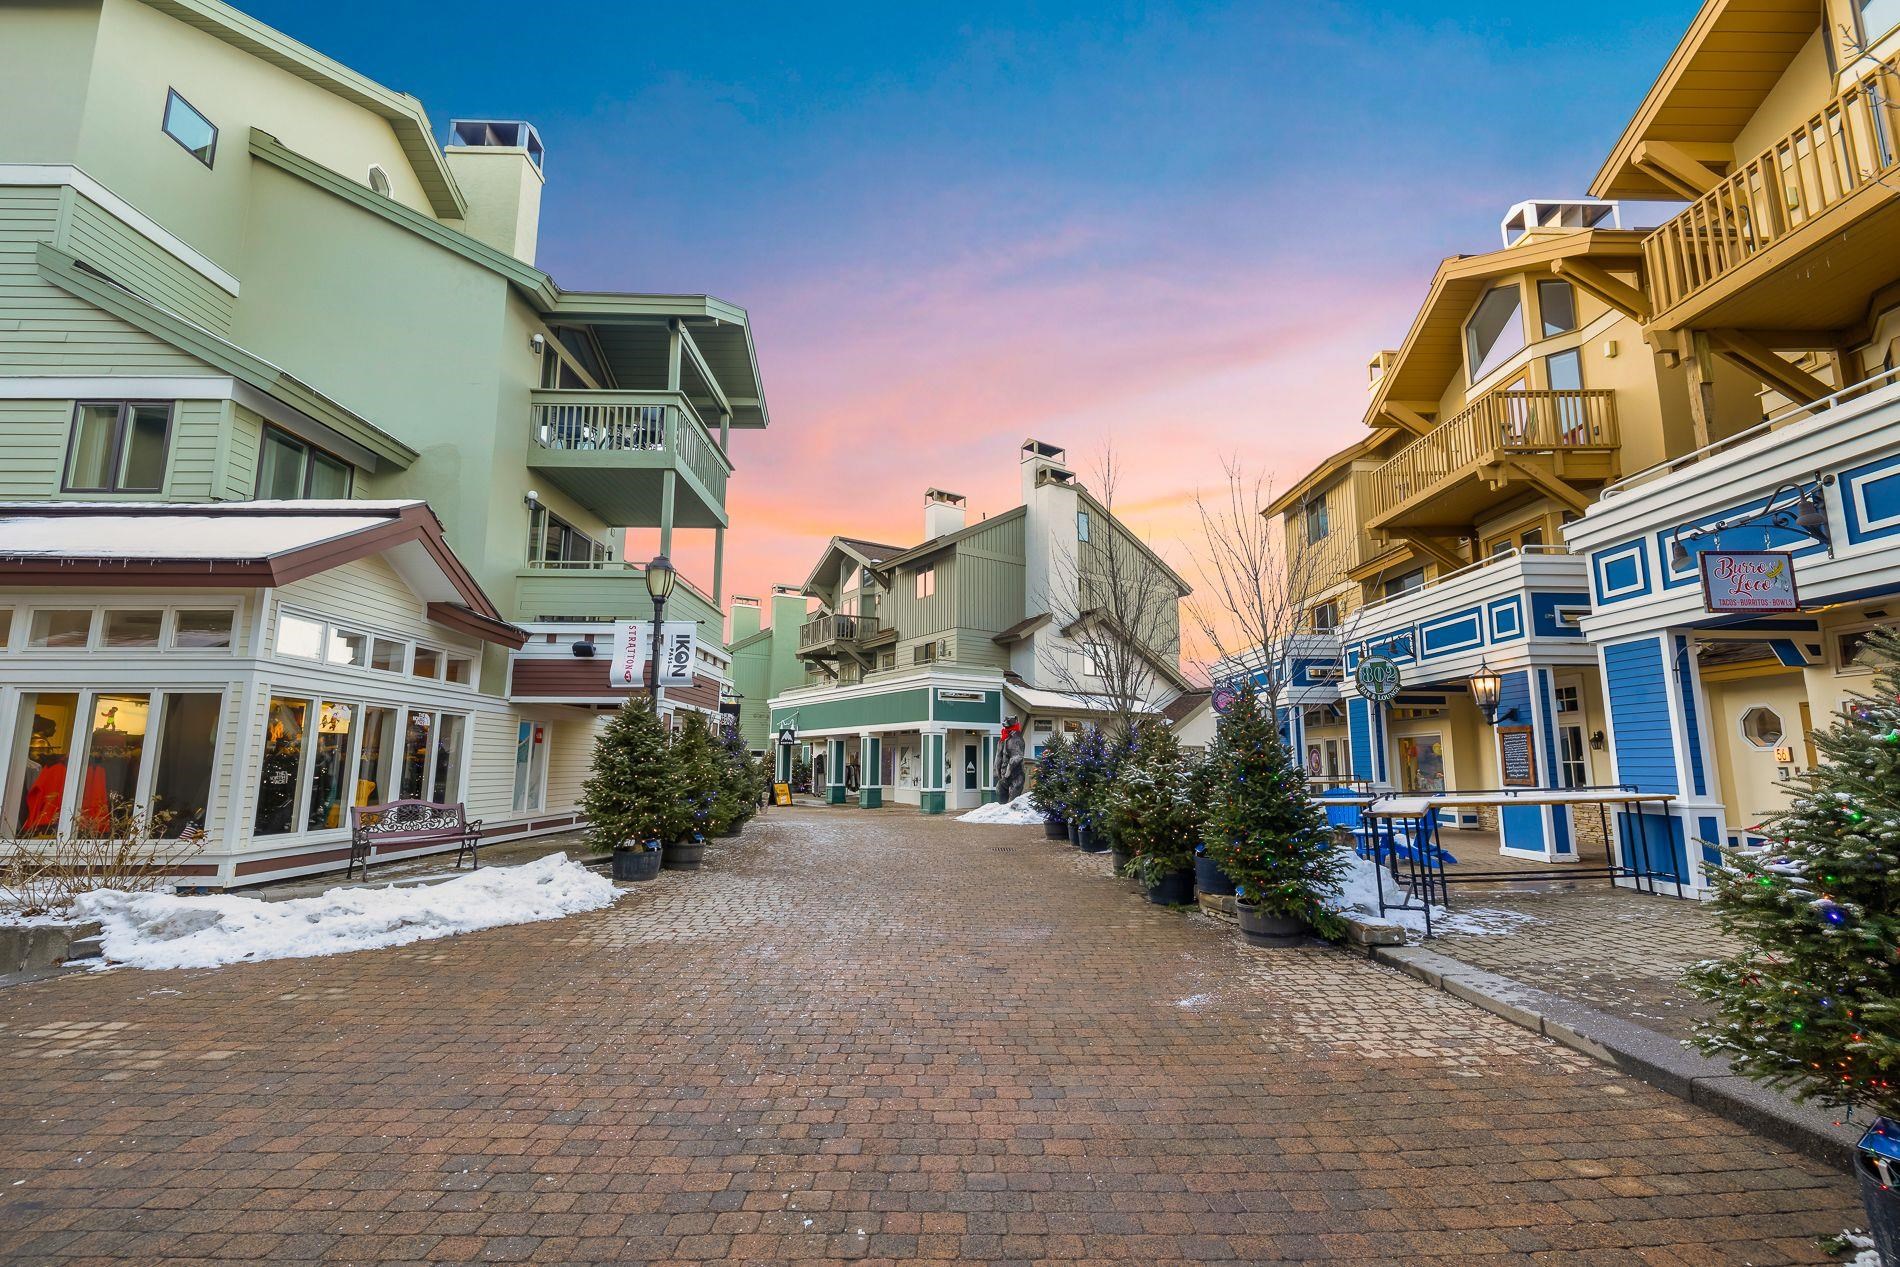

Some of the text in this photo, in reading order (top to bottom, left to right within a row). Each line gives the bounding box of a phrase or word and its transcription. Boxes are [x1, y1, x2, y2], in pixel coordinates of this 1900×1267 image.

[1714, 556, 1767, 579] Burro
[1728, 574, 1773, 597] Loco
[1718, 598, 1793, 607] TACOS BURRITOS BOWLS
[625, 625, 637, 670] STRATTON
[671, 634, 691, 677] IKON
[1362, 666, 1397, 683] 802
[1359, 685, 1371, 698] BAR
[1377, 686, 1401, 701] LOUNGE
[1777, 748, 1787, 760] 56
